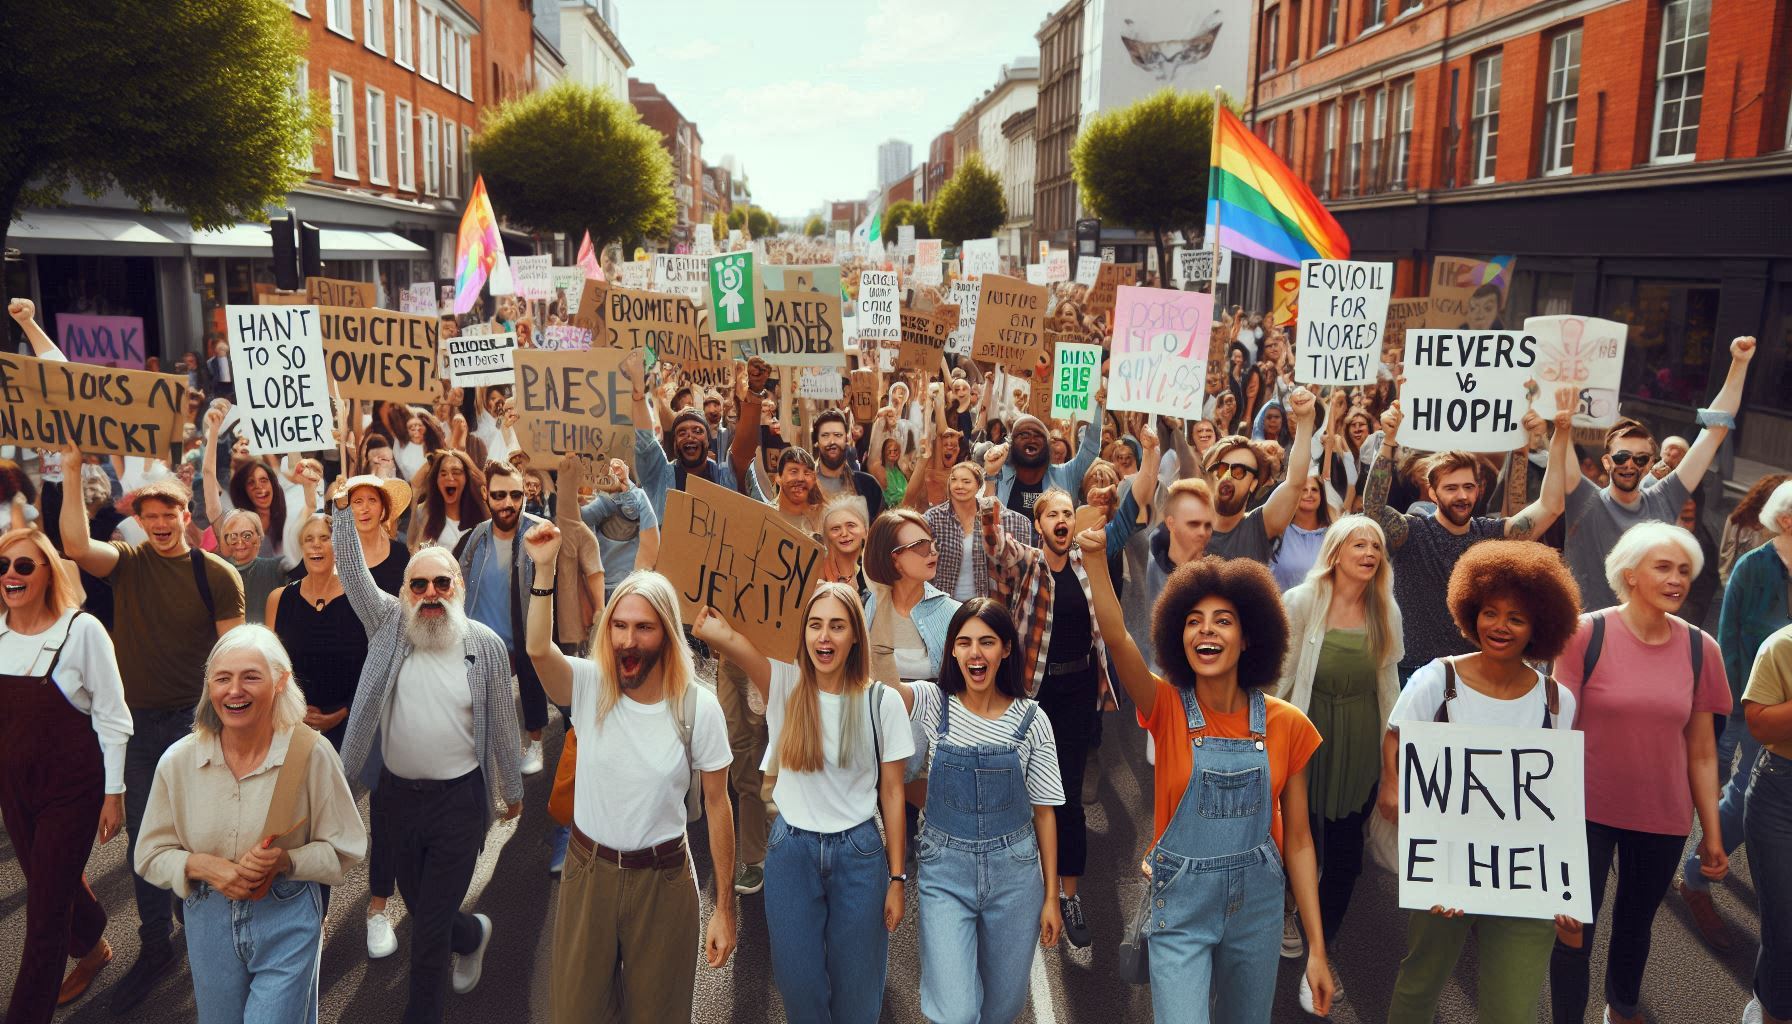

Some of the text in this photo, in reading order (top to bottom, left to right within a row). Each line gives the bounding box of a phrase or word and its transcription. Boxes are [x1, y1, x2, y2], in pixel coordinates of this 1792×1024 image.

[1331, 296, 1366, 319] FOR
[243, 344, 306, 370] TO SO
[1415, 334, 1537, 368] HEVERS
[247, 374, 314, 409] LOBE
[251, 413, 325, 449] MIGER
[1413, 397, 1518, 433] HIOPH.
